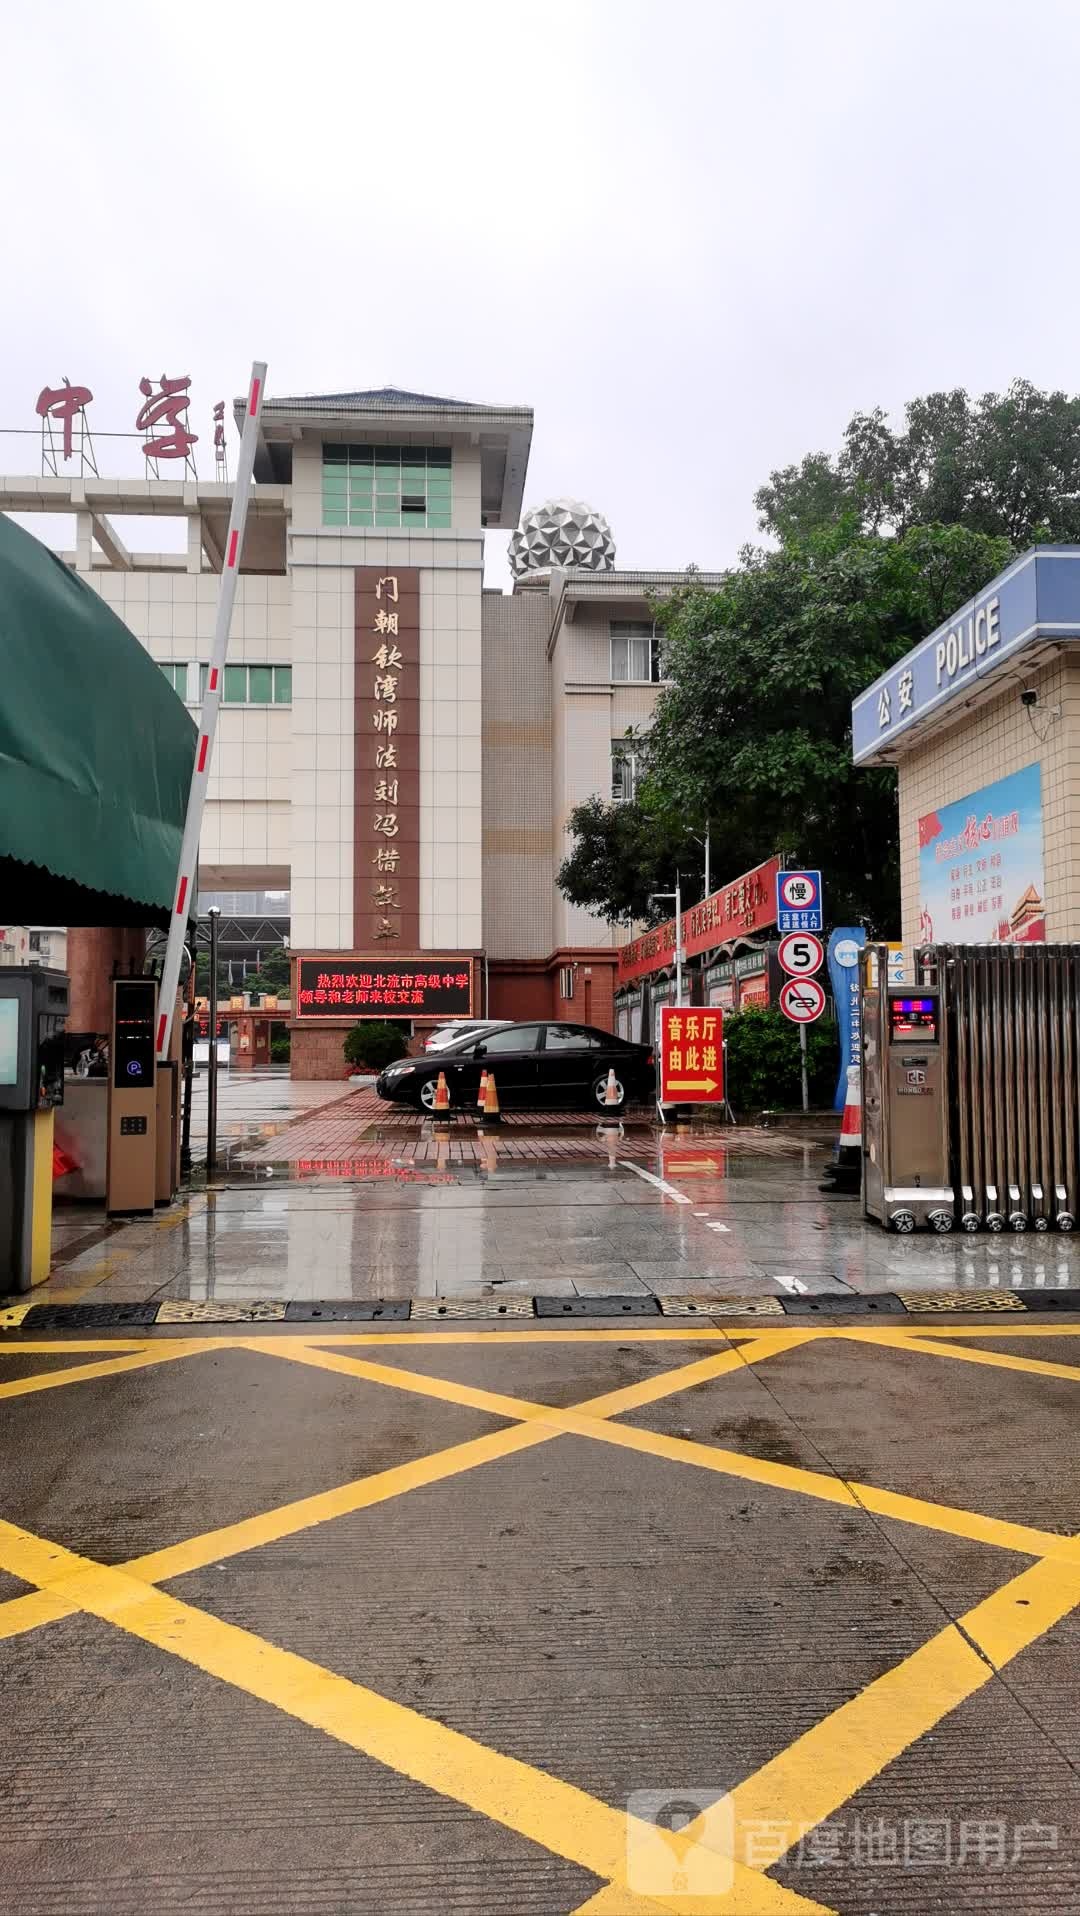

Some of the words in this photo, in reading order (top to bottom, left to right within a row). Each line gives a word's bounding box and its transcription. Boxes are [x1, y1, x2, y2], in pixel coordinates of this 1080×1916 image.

[35, 374, 198, 461] 中学
[936, 597, 999, 685] POLICE
[878, 671, 912, 727] 公安
[790, 883, 807, 900] 慢
[782, 913, 817, 921] 注意行人
[793, 944, 810, 966] 5
[317, 974, 468, 989] 热烈欢迎北流市高级中学
[301, 990, 424, 1004] 领导和老师来校交流
[668, 1016, 717, 1041] 音乐厅
[669, 1046, 717, 1071] 由此进
